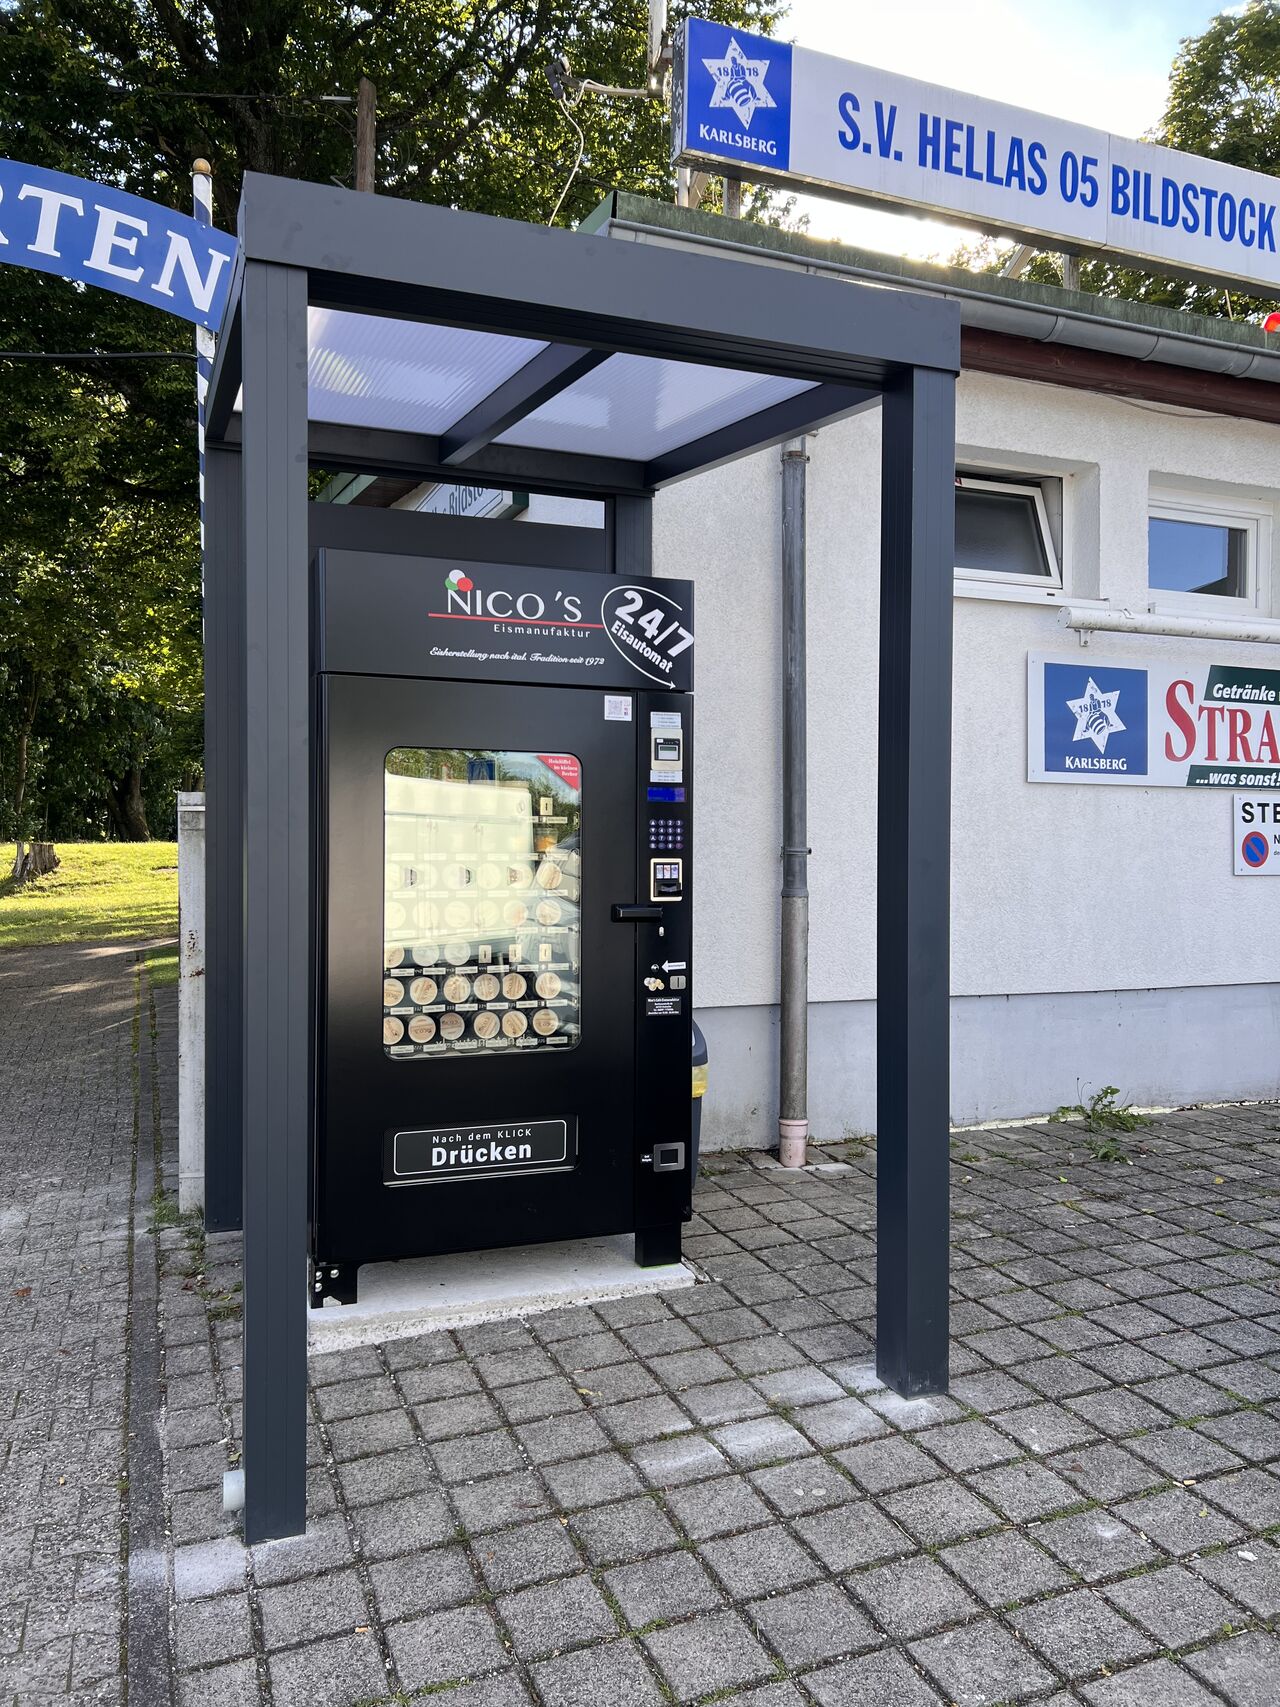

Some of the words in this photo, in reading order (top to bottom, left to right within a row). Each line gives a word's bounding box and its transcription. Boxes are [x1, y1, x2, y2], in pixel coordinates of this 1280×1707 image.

[718, 67, 730, 77] 18
[699, 123, 777, 156] KARLSBERG
[838, 92, 902, 161] S.V.
[918, 112, 1048, 196] HELLAS
[1059, 151, 1099, 208] 05
[1111, 165, 1277, 253] BILDSTOCK
[0, 182, 230, 312] TEN
[493, 623, 591, 638] Eismanufaktur
[614, 590, 695, 658] 24/7
[429, 646, 488, 661] Eisherstellung
[489, 650, 510, 661] nach
[511, 651, 528, 661] ital.
[529, 652, 568, 664] Tradition
[569, 654, 584, 664] seit
[585, 656, 605, 666] 1972
[611, 620, 673, 673] Eisautomat
[1212, 683, 1276, 702] Getränke
[1078, 703, 1089, 713] 18
[1065, 755, 1127, 771] KARLSBERG
[432, 1134, 462, 1144] Nach
[468, 1131, 491, 1141] dem
[497, 1128, 532, 1139] KLICK
[431, 1142, 532, 1166] Drücken
